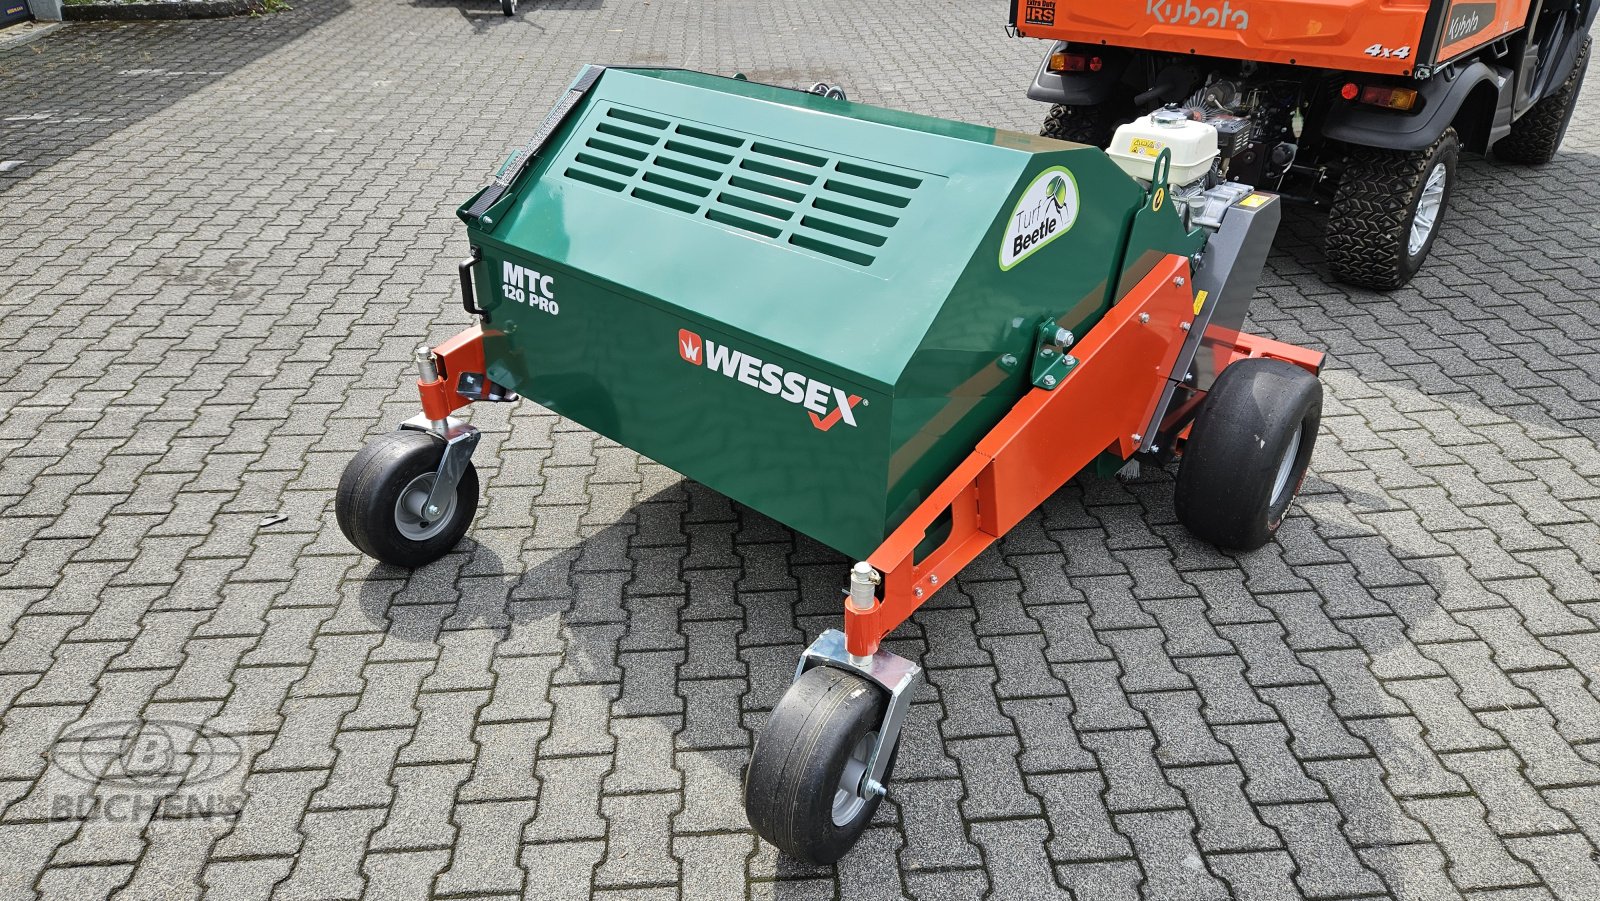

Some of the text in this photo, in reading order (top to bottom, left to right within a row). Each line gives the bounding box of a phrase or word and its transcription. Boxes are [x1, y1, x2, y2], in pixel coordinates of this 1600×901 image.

[1026, 7, 1054, 21] IRS
[1146, 0, 1249, 30] Kubota
[1449, 11, 1479, 40] Kubota
[1364, 43, 1411, 59] 4x4
[1016, 199, 1042, 233] Turf
[1013, 217, 1057, 257] Beetle
[503, 260, 554, 299] MTC
[502, 283, 559, 316] 120 PRO
[705, 339, 863, 431] WESSEX
